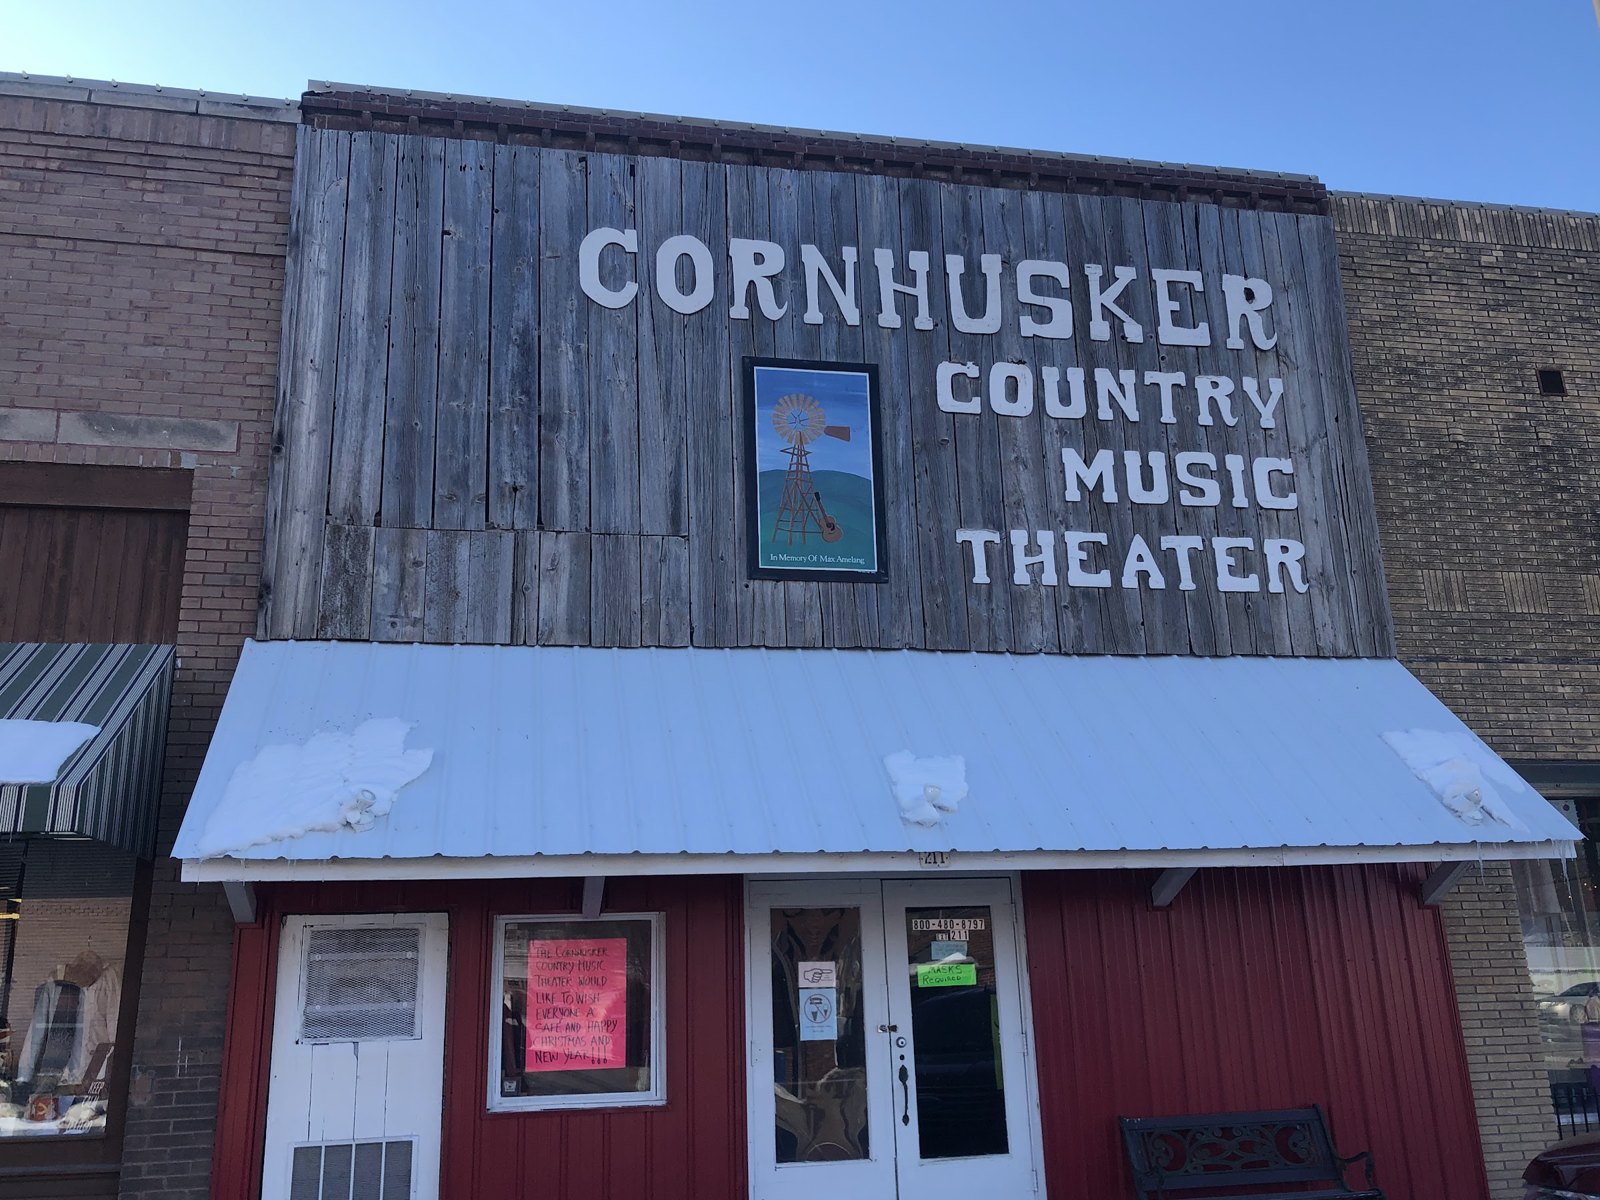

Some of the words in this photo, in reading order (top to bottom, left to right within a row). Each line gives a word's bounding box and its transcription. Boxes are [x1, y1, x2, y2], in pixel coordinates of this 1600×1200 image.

[578, 227, 1278, 350] CORNHUSKER
[936, 361, 1284, 429] COUNTRY
[1061, 447, 1298, 510] MUSIC
[770, 553, 778, 561] In
[779, 553, 807, 563] Memory
[808, 554, 817, 562] Of
[820, 555, 835, 563] Max
[956, 529, 1309, 594] THEATER
[913, 919, 984, 930] 800-480-8797
[951, 930, 968, 940] 211
[536, 961, 574, 974] COUNTRY
[578, 960, 606, 971] MUSIC
[928, 964, 962, 974] MASKS
[535, 975, 572, 987] THEATER
[579, 975, 607, 986] WOULD
[536, 992, 555, 1004] LIKE
[562, 991, 575, 1004] TO
[576, 992, 600, 1004] WISH
[536, 1007, 578, 1023] EVERYONE
[587, 1008, 594, 1017] A
[535, 1023, 560, 1032] SAFE
[566, 1024, 581, 1032] AND
[588, 1019, 617, 1033] HAPPY
[533, 1035, 586, 1047] CHRISTMAS
[591, 1035, 610, 1046] AND
[535, 1050, 558, 1063] NEW
